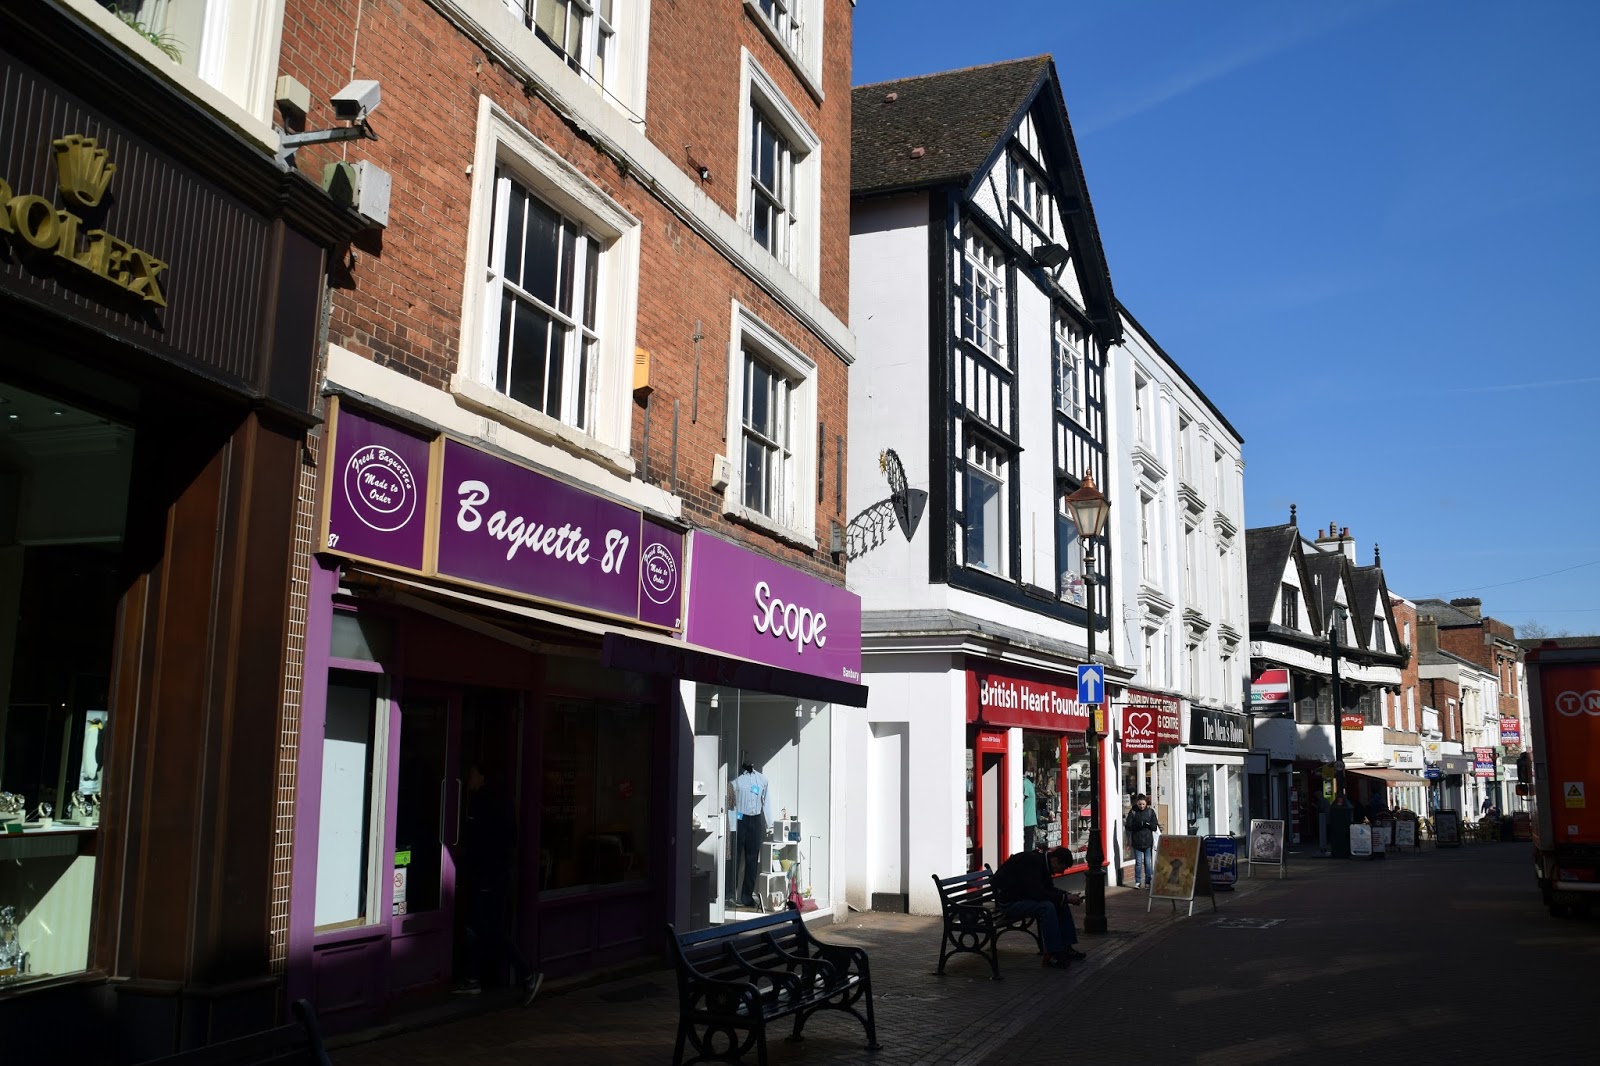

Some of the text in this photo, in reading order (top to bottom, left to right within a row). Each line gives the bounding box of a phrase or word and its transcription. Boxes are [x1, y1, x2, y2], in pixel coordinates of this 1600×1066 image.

[352, 448, 412, 490] Fresh Baguettes
[364, 472, 399, 492] Made to
[369, 488, 392, 504] Order
[456, 479, 630, 575] Baguette 81
[327, 533, 340, 548] 81
[753, 581, 827, 654] Scope
[842, 666, 859, 681] Banbury
[980, 679, 1018, 709] British
[1020, 685, 1050, 713] Heart
[1162, 716, 1179, 730] CENTRE
[1202, 716, 1214, 740] The
[1214, 718, 1230, 742] Men's
[1230, 722, 1244, 743] Room
